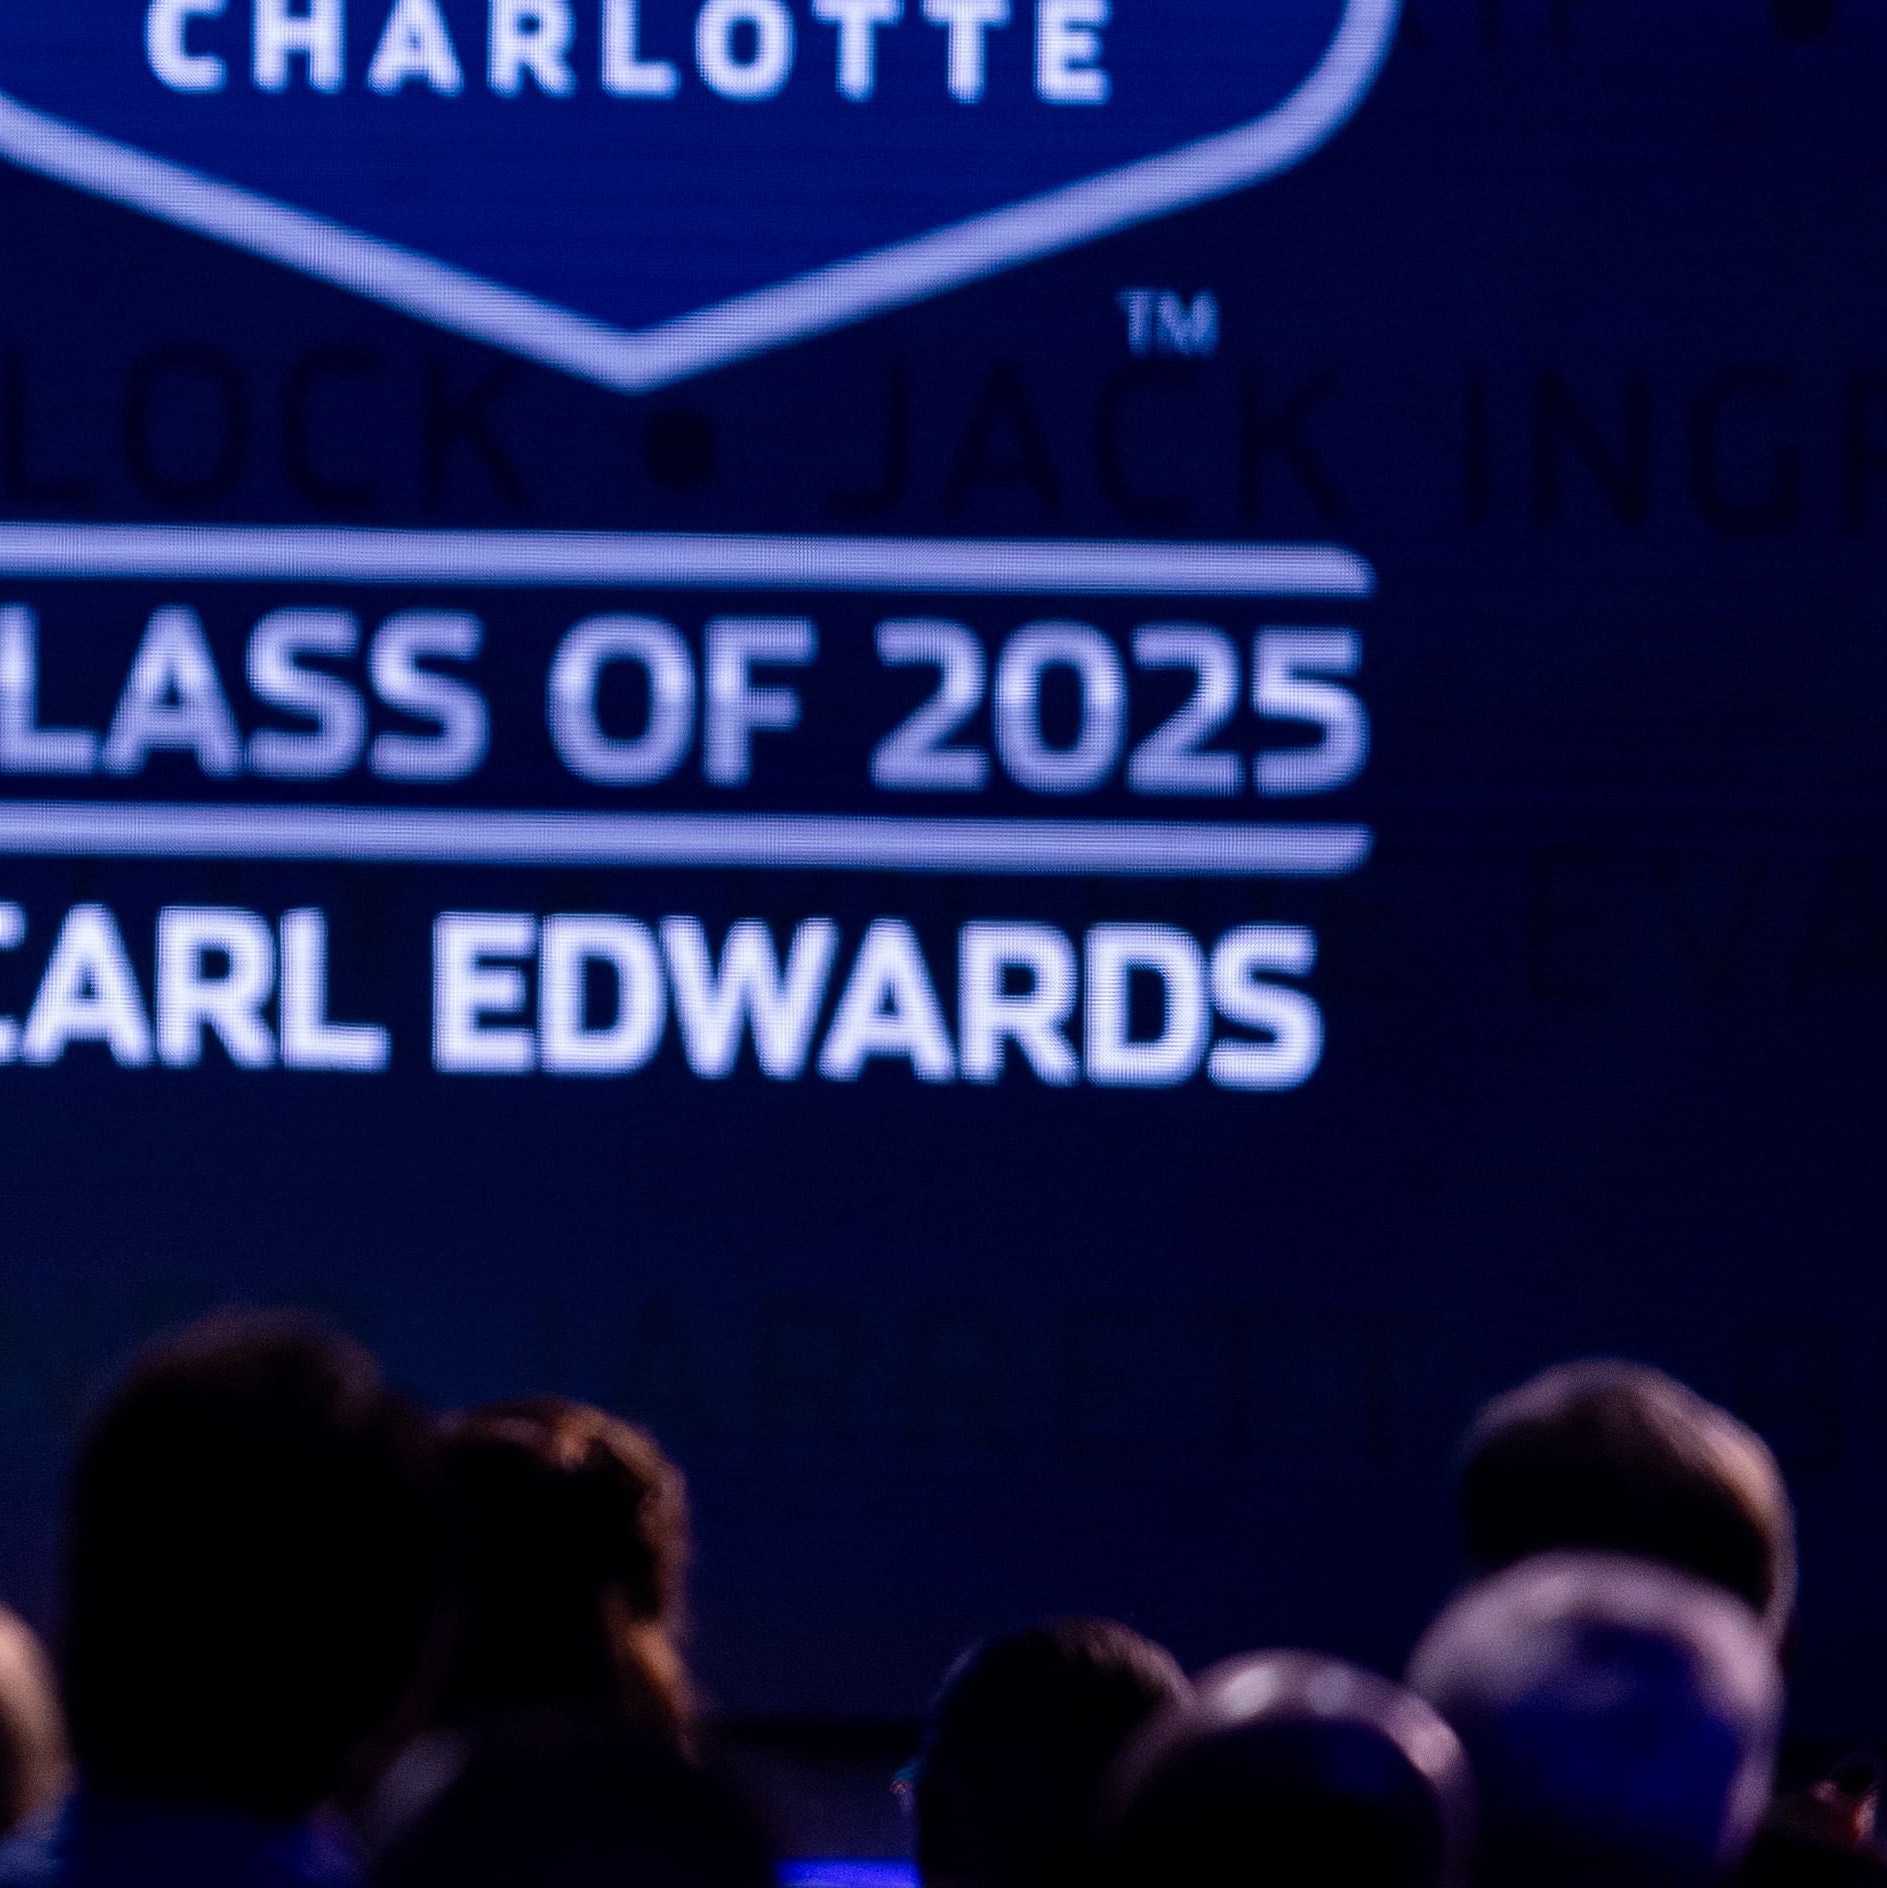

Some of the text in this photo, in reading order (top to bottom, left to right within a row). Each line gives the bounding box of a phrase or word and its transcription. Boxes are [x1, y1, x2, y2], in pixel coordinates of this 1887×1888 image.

[546, 615, 814, 783] OF
[872, 619, 1366, 794] 2025
[430, 912, 1323, 1090] EDWARDS
